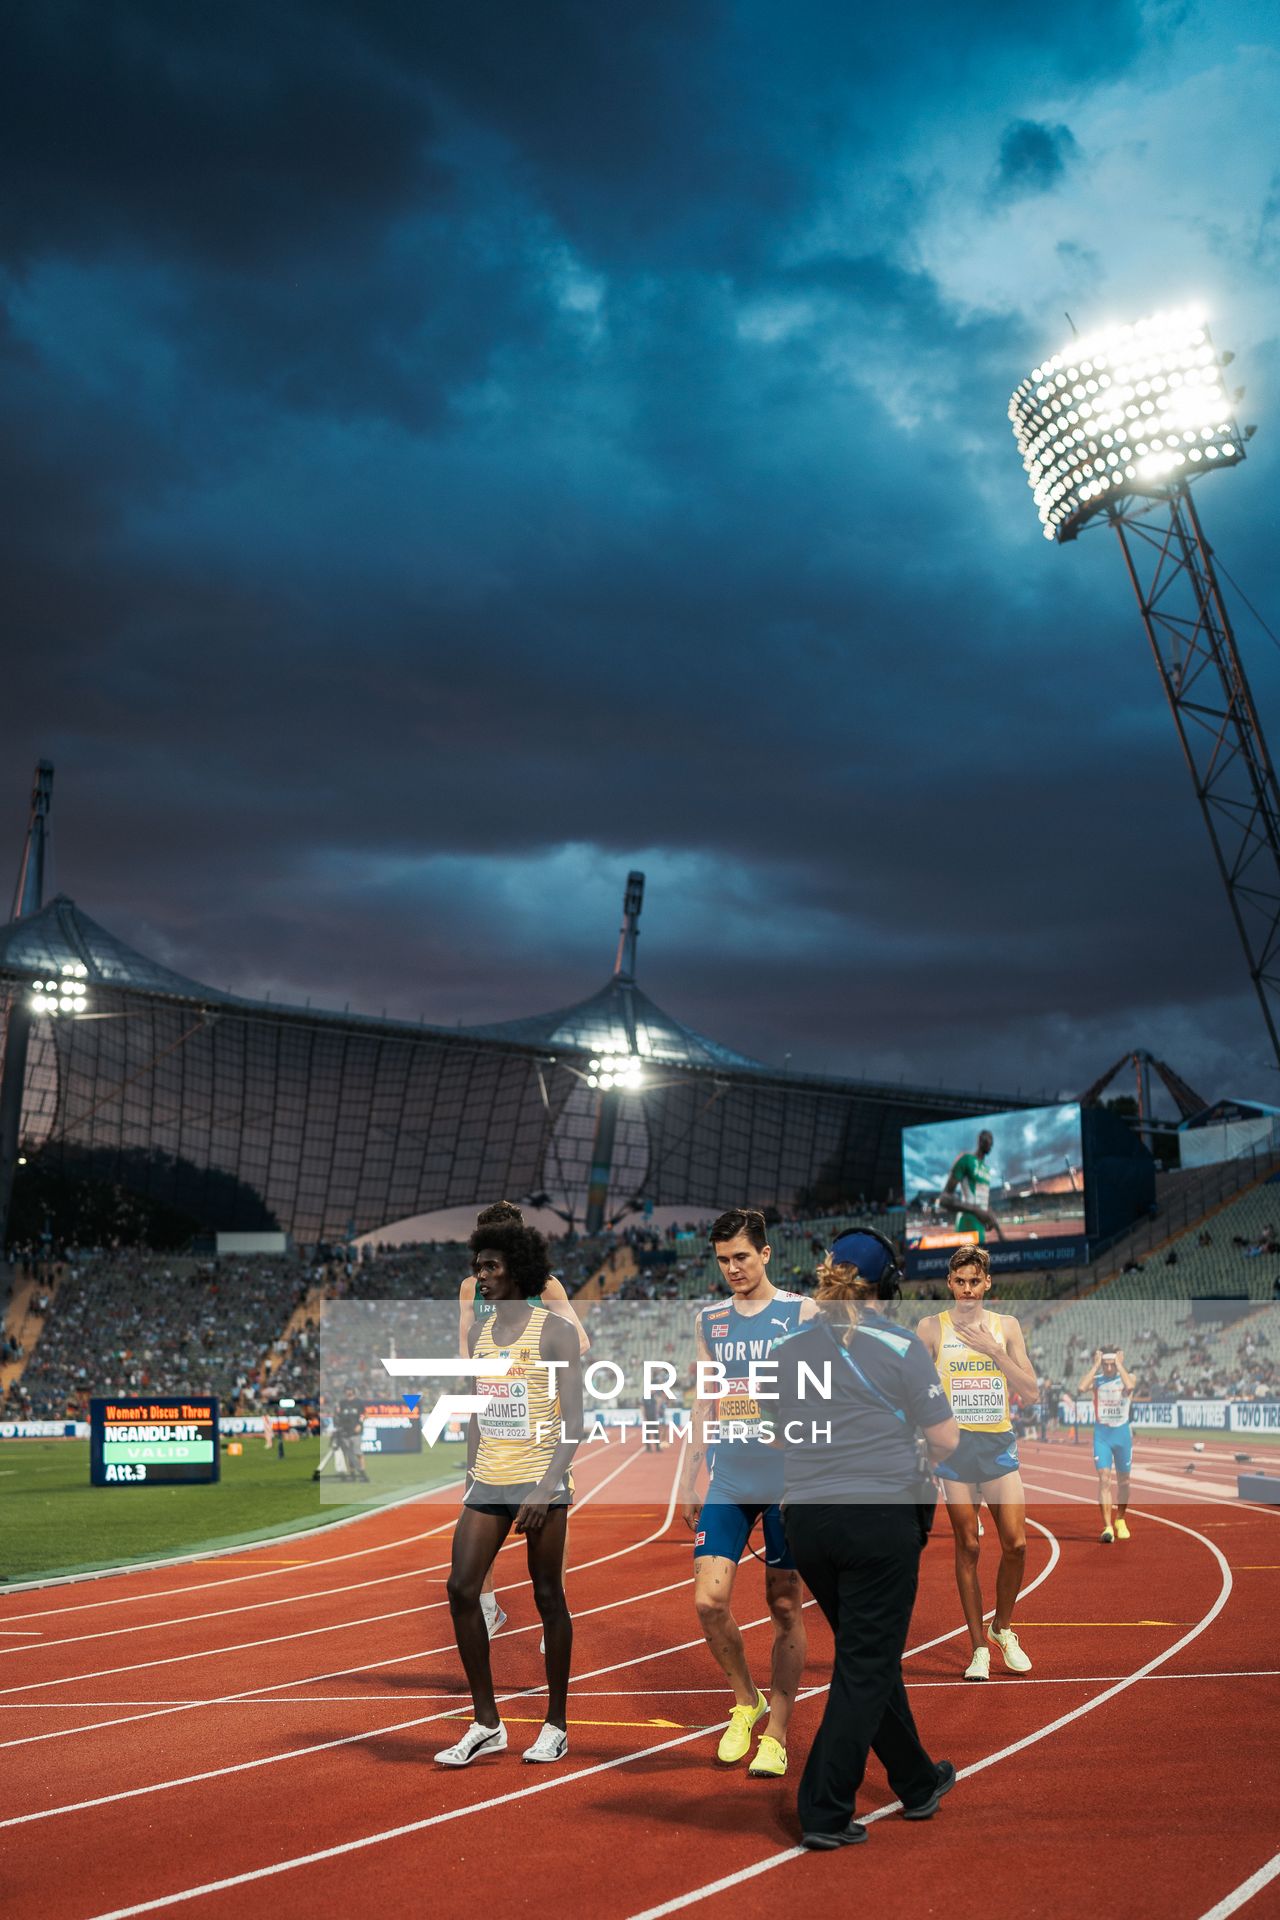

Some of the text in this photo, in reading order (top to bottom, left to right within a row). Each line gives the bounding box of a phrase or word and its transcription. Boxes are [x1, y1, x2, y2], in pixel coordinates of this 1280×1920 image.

[949, 1361, 1001, 1372] SWEDEN
[477, 1383, 509, 1396] SPAR
[952, 1378, 991, 1390] SPAR
[952, 1392, 1004, 1407] PIHLSTRÖM
[106, 1404, 211, 1420] Women's Discus Throw
[1102, 1407, 1121, 1415] FRIS
[1132, 1405, 1173, 1424] OYO TIRES
[1237, 1406, 1260, 1427] TOYO
[954, 1414, 1003, 1422] MUNICH 2022
[105, 1426, 203, 1442] NGANDU-NT.
[506, 1428, 527, 1437] 2022
[127, 1447, 190, 1458] VALID
[105, 1464, 147, 1481] Att.3
